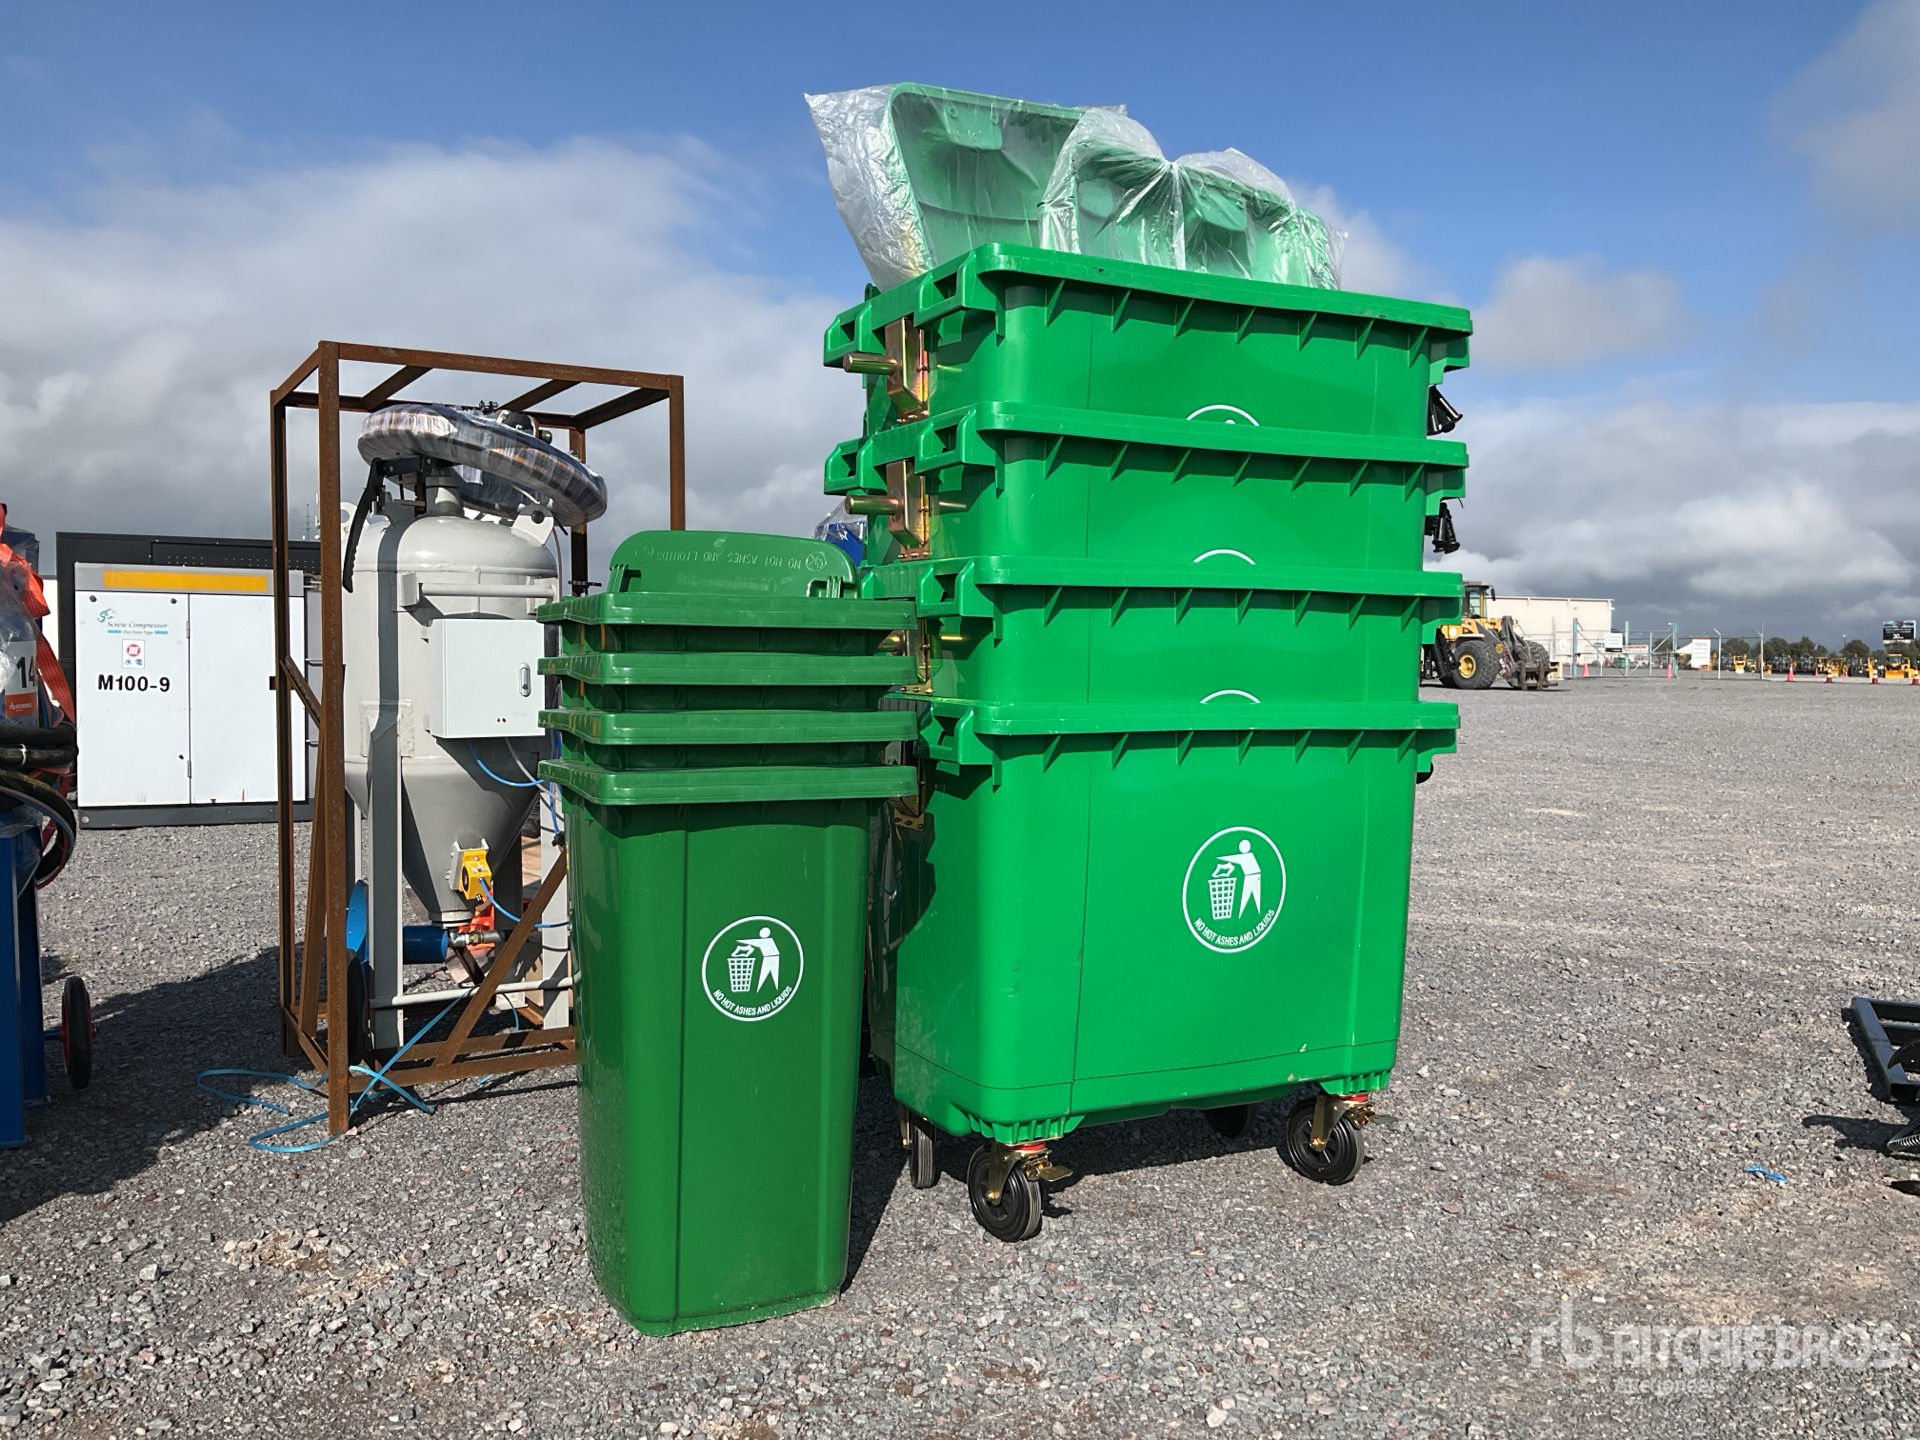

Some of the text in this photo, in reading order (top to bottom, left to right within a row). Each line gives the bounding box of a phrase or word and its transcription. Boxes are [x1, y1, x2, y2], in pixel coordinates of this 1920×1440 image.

[727, 552, 758, 565] ASHES
[764, 554, 783, 568] HOT
[787, 559, 802, 569] NO
[128, 621, 168, 629] Compressor
[97, 674, 171, 692] M100-9
[1194, 909, 1275, 947] NO HOT ASHES AND LIQUIDS
[713, 985, 793, 1016] NO HOT ASHES AND LIQUIDS
